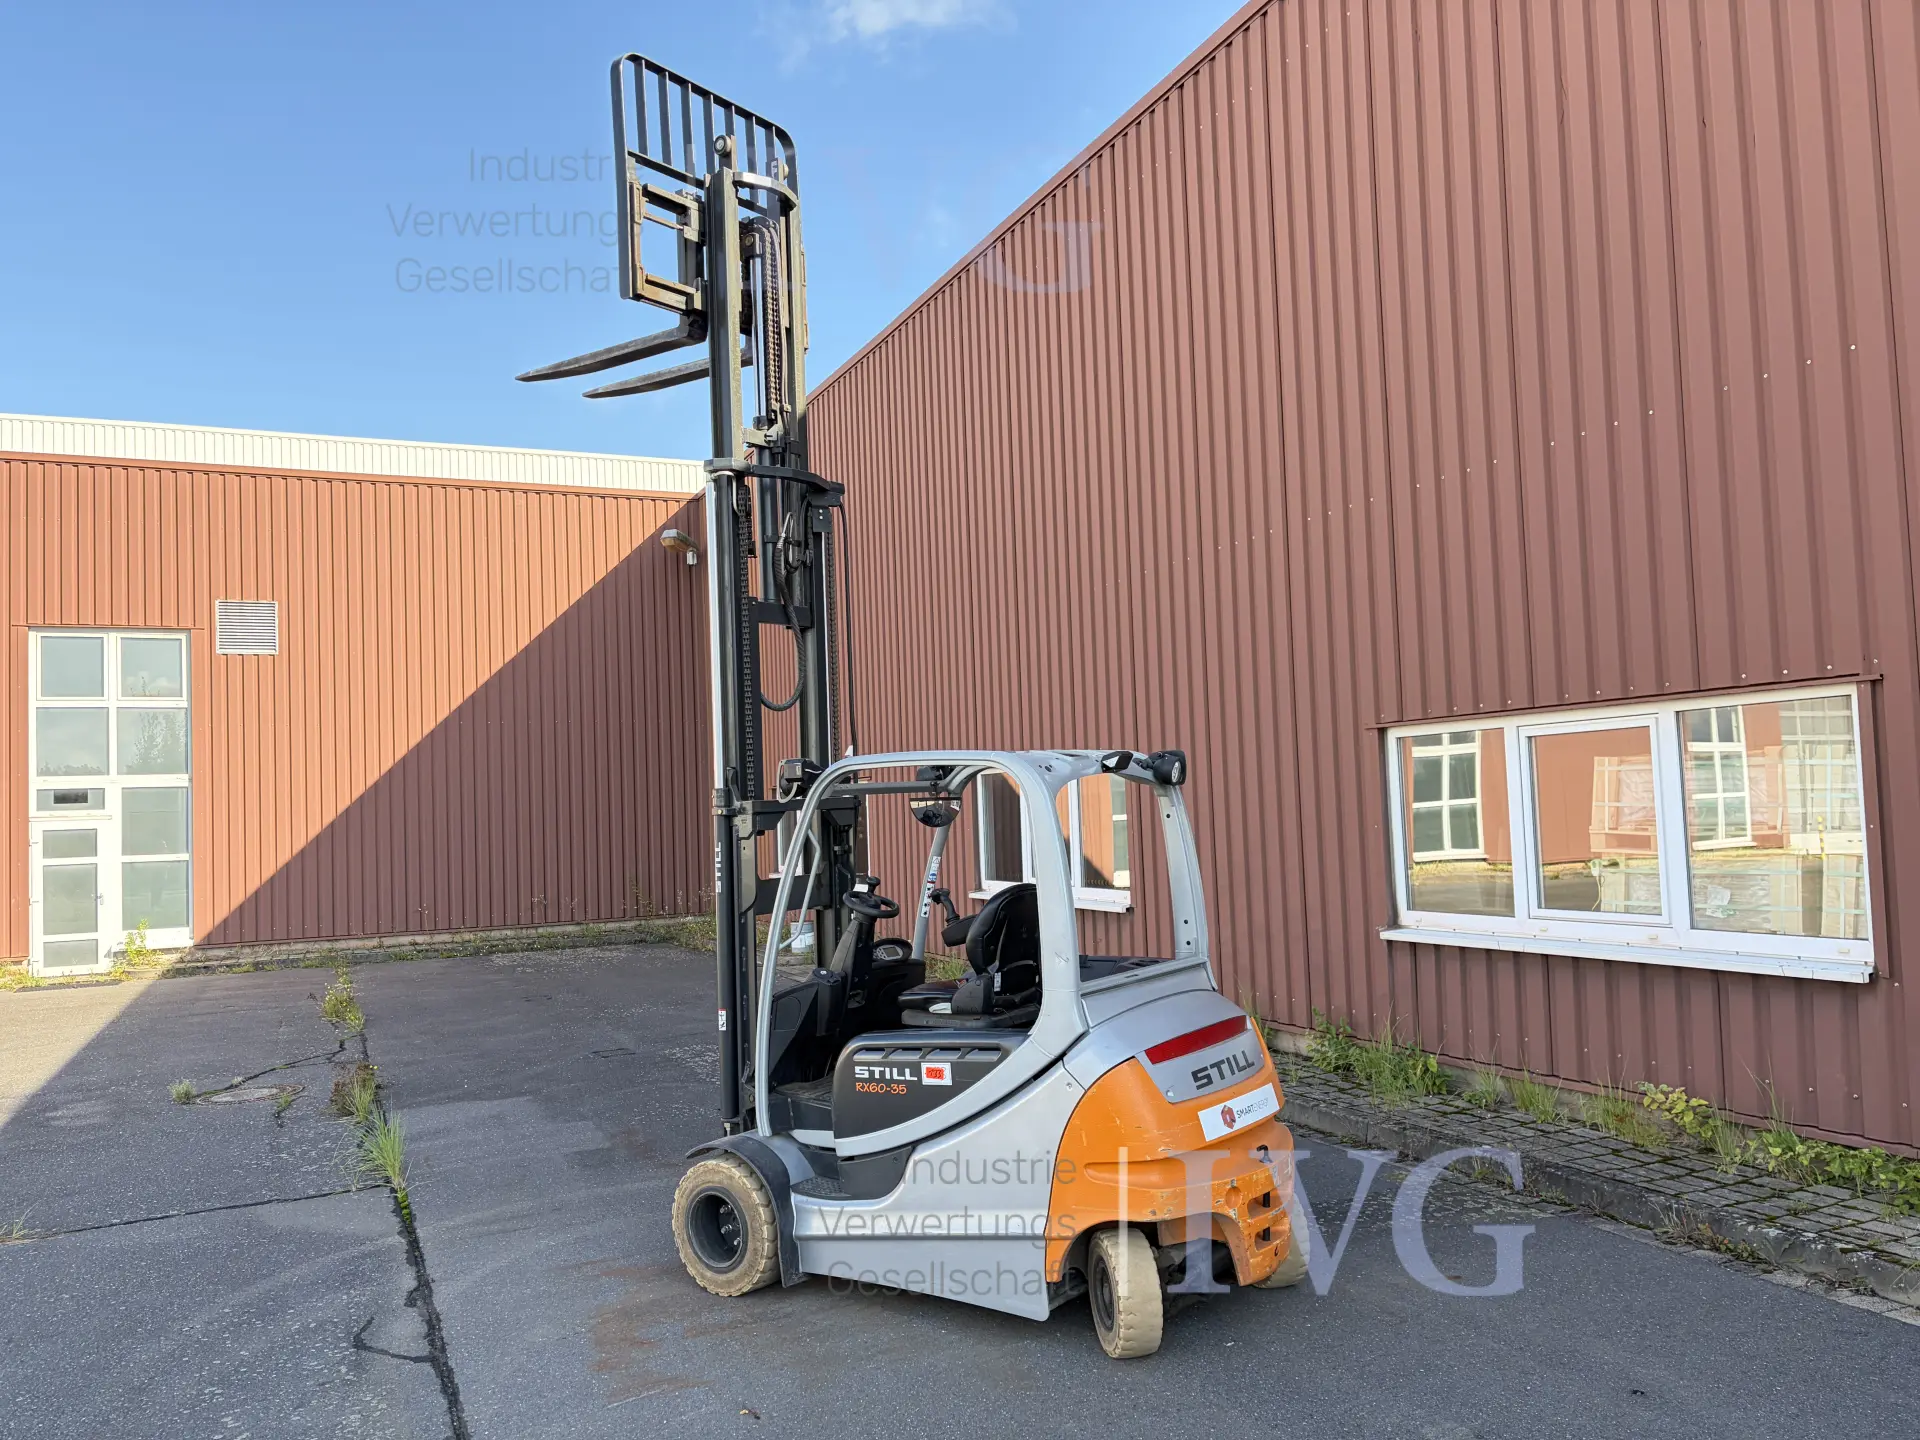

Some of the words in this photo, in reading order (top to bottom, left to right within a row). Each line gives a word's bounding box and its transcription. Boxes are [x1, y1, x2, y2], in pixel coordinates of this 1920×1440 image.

[854, 1065, 918, 1081] STILL
[1190, 1049, 1256, 1091] STILL
[855, 1081, 907, 1095] RX60-35
